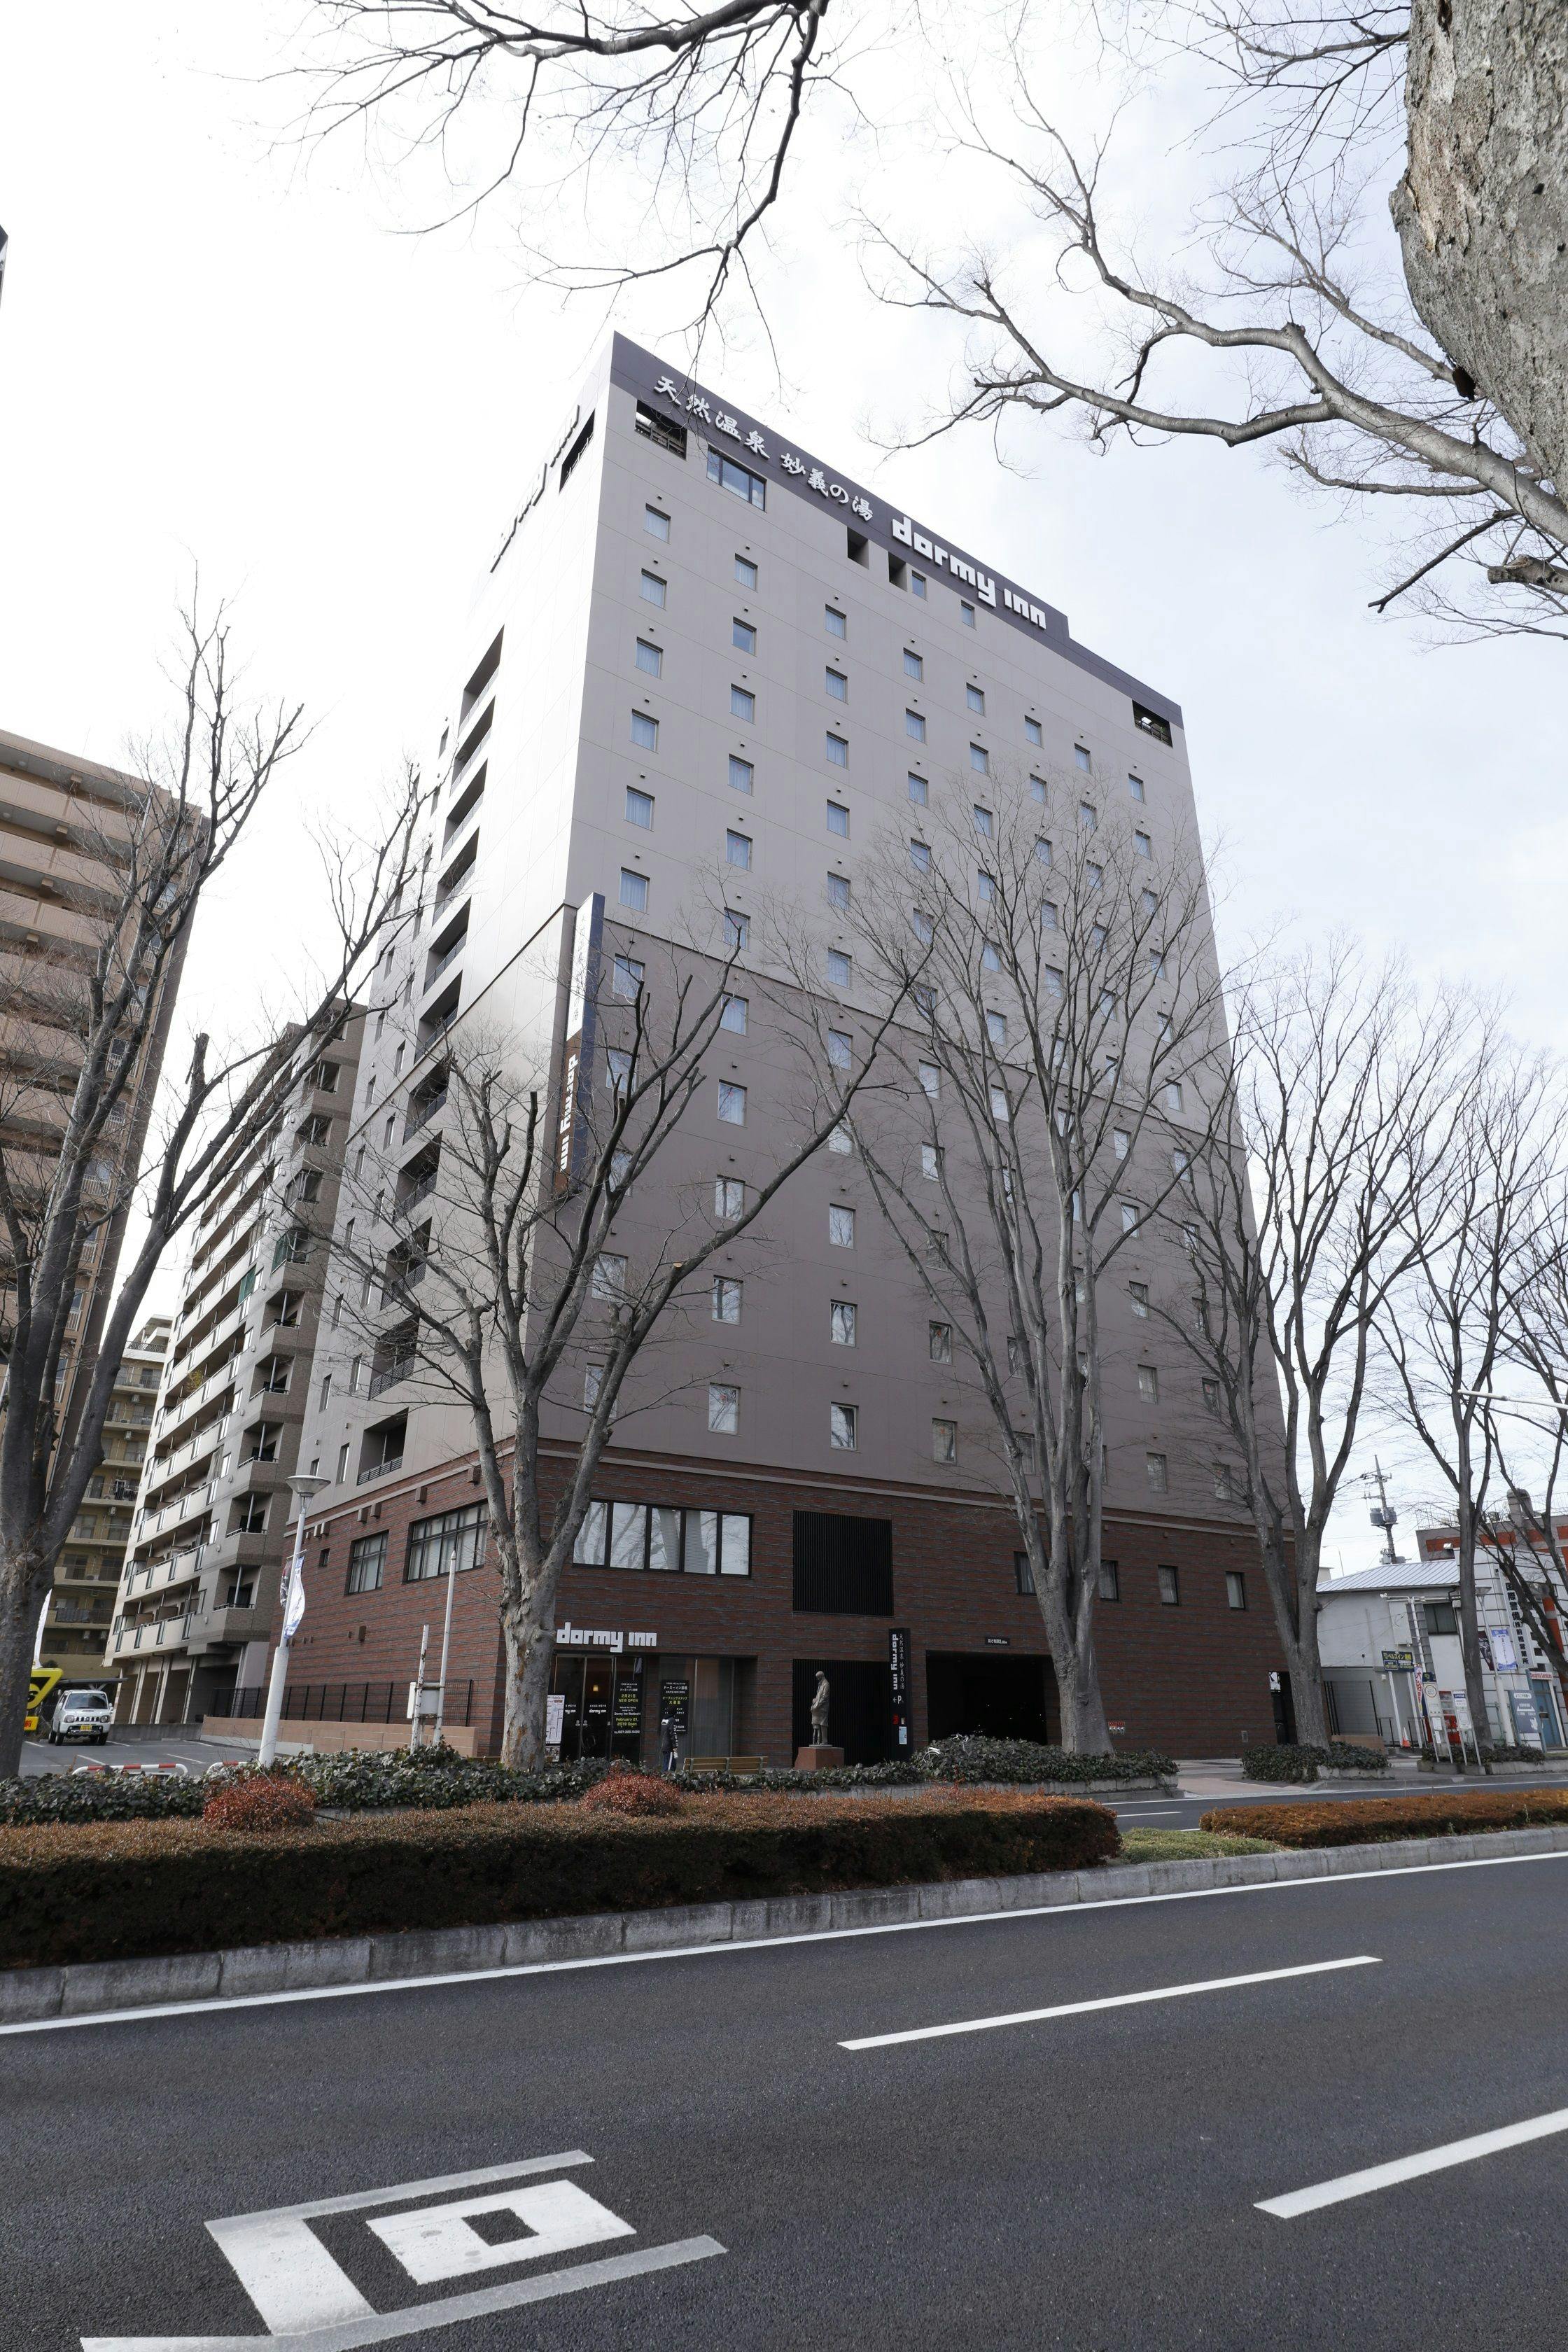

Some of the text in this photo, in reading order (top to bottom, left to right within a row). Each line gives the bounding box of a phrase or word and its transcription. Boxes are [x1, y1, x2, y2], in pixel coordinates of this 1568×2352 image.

[654, 376, 874, 522] 天然温泉 妙義の湯
[892, 517, 1046, 629] dormy inn
[560, 1054, 578, 1172] dormy inn
[556, 1622, 657, 1653] dormy inn
[890, 1634, 899, 1671] dormy
